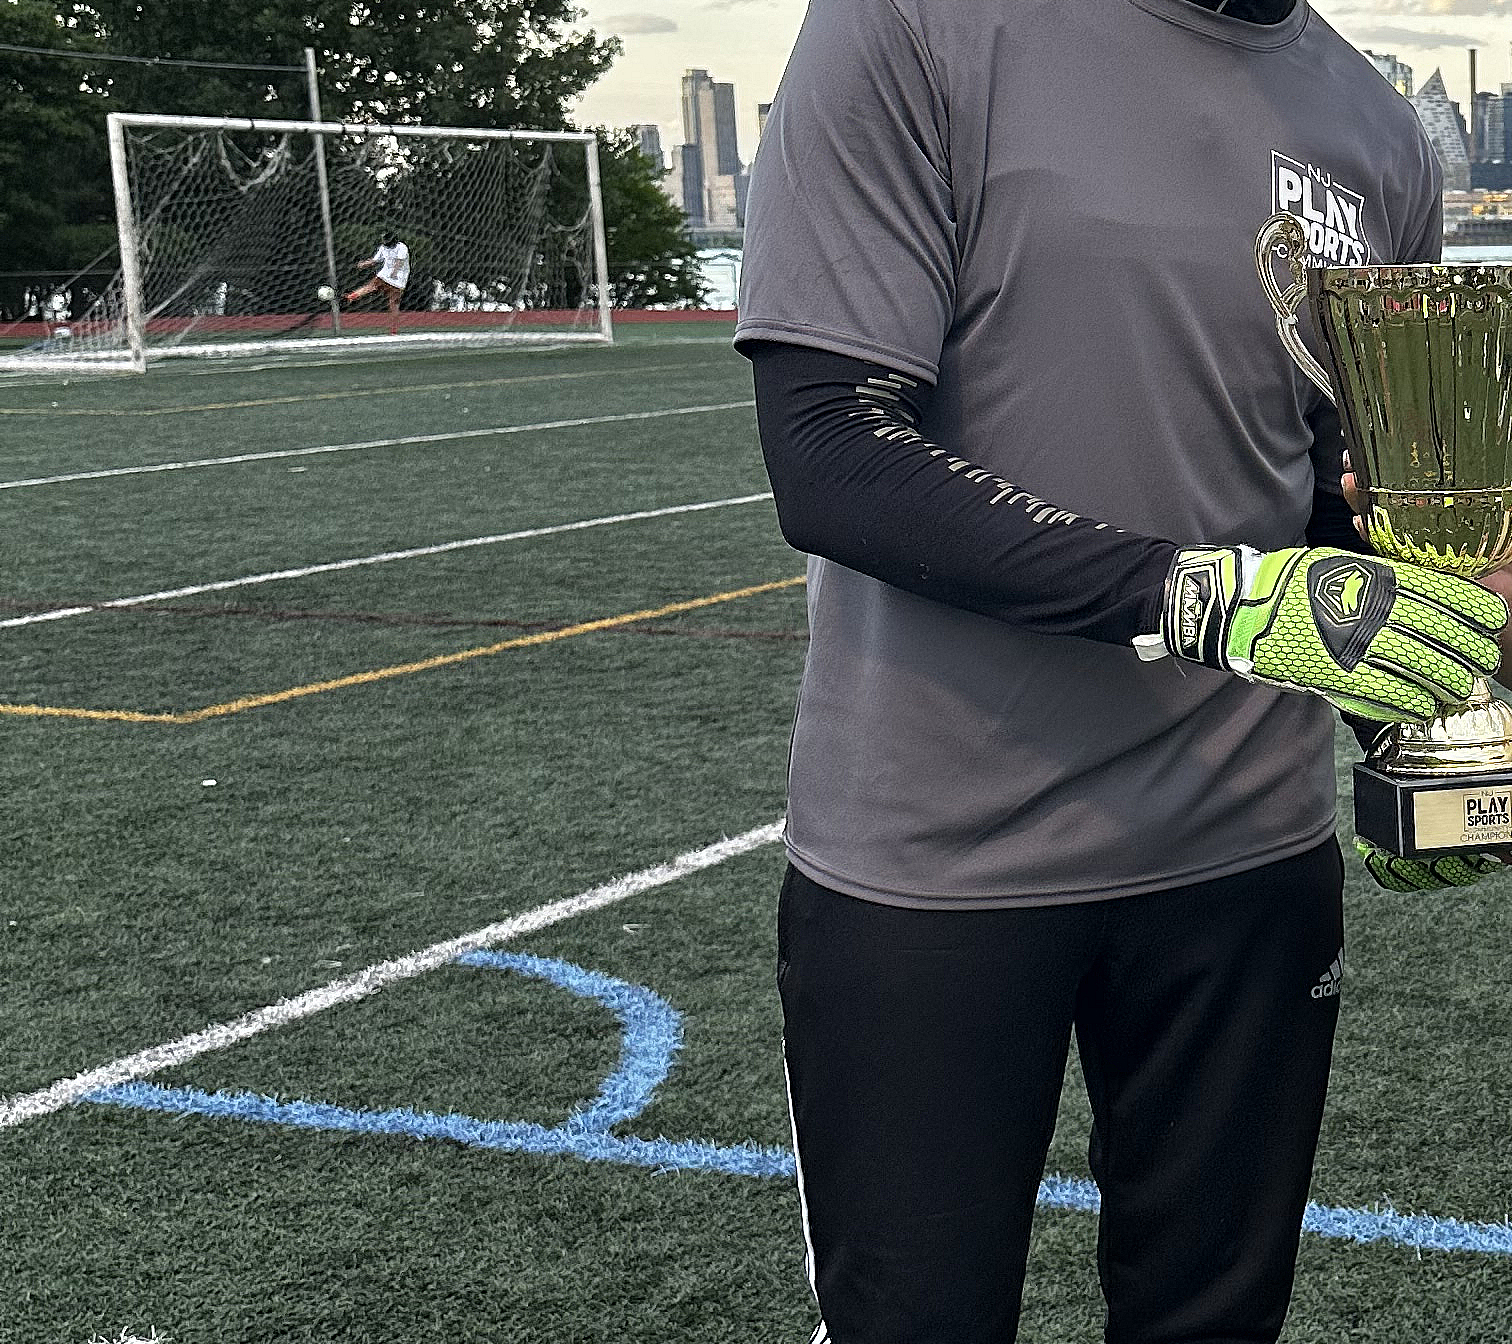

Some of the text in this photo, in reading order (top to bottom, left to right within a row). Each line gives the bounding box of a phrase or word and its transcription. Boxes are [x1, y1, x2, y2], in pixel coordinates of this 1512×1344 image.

[1307, 163, 1332, 188] NJ
[1278, 166, 1359, 241] PLAY
[1293, 215, 1366, 267] PORTS
[1466, 796, 1509, 816] PLAY
[1467, 812, 1510, 827] SPORTS
